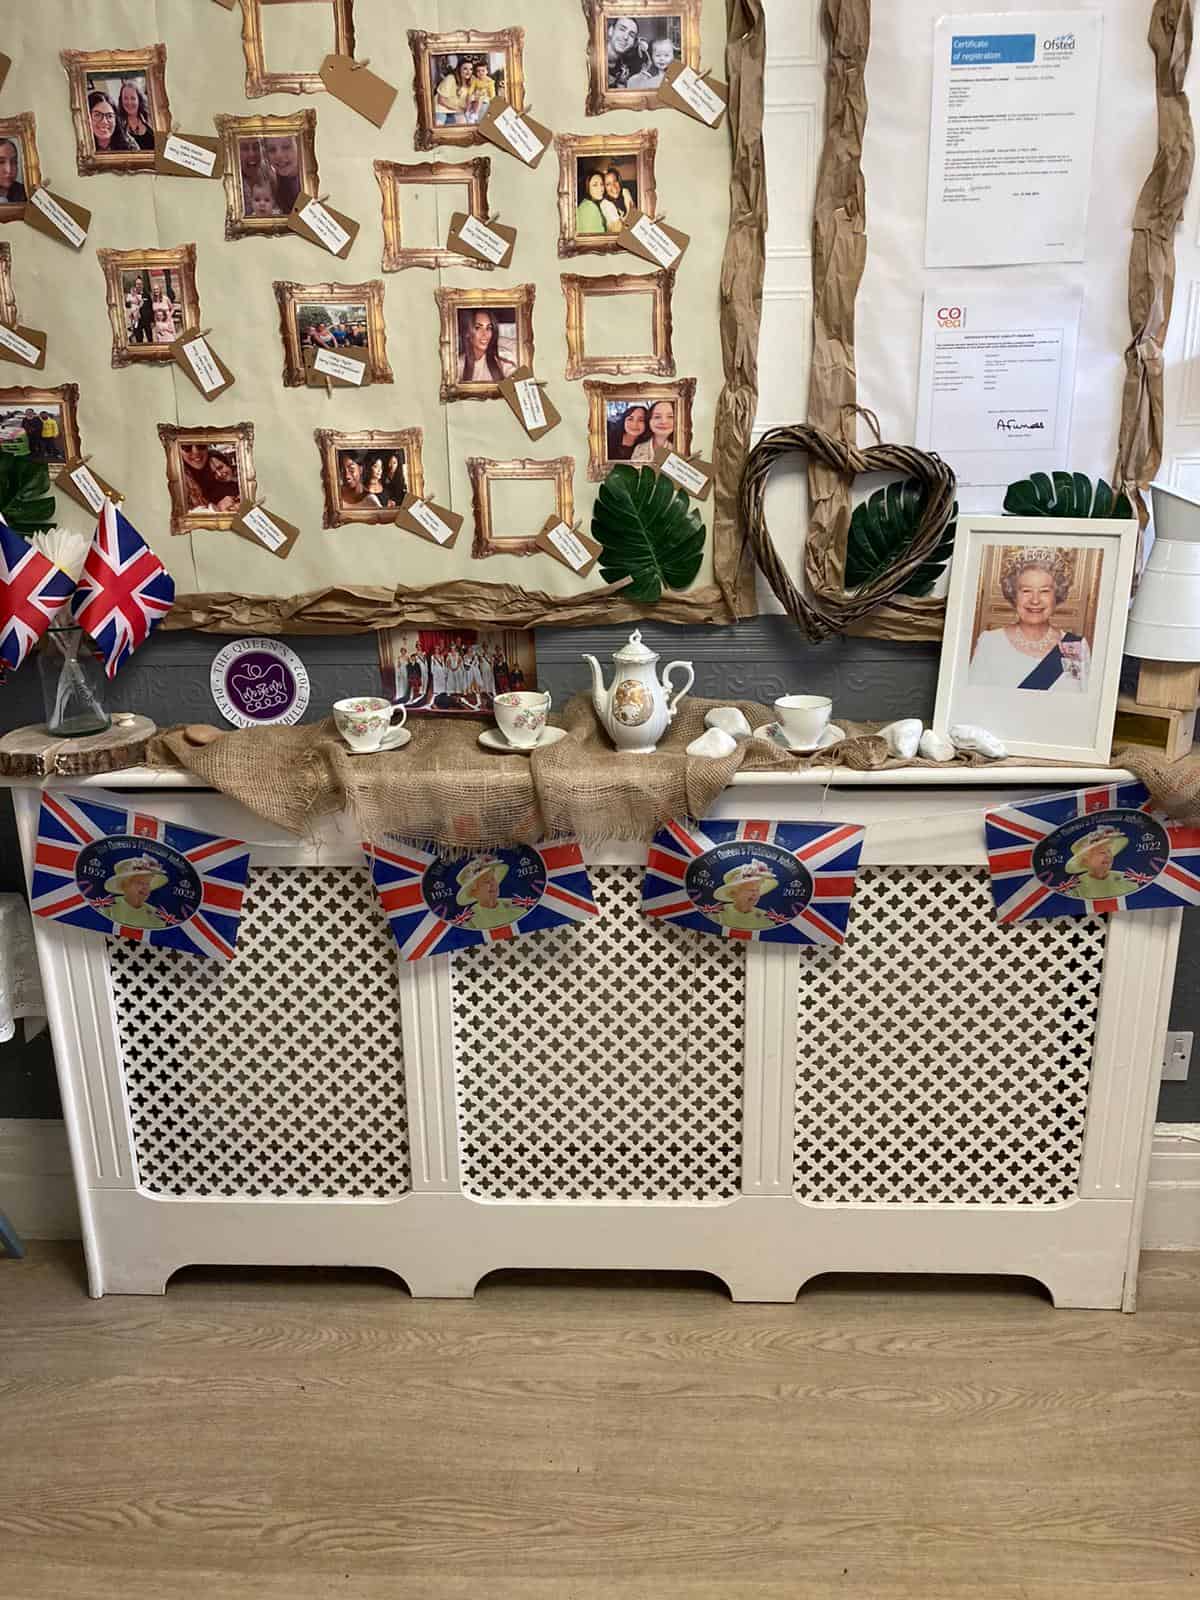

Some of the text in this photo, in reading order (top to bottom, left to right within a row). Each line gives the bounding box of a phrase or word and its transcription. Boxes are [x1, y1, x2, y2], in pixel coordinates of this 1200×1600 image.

[953, 40, 989, 49] Certificate
[1043, 40, 1075, 50] Ofsted
[952, 53, 961, 61] of
[215, 640, 289, 672] THE QUEEN'S
[214, 688, 257, 727] PLATINU
[1136, 841, 1160, 853] 2022
[1041, 856, 1064, 866] 1952
[83, 865, 106, 878] 1952
[517, 865, 539, 878] 2022
[173, 887, 195, 898] 2022
[431, 888, 454, 900] 1952
[783, 888, 805, 897] 2022
